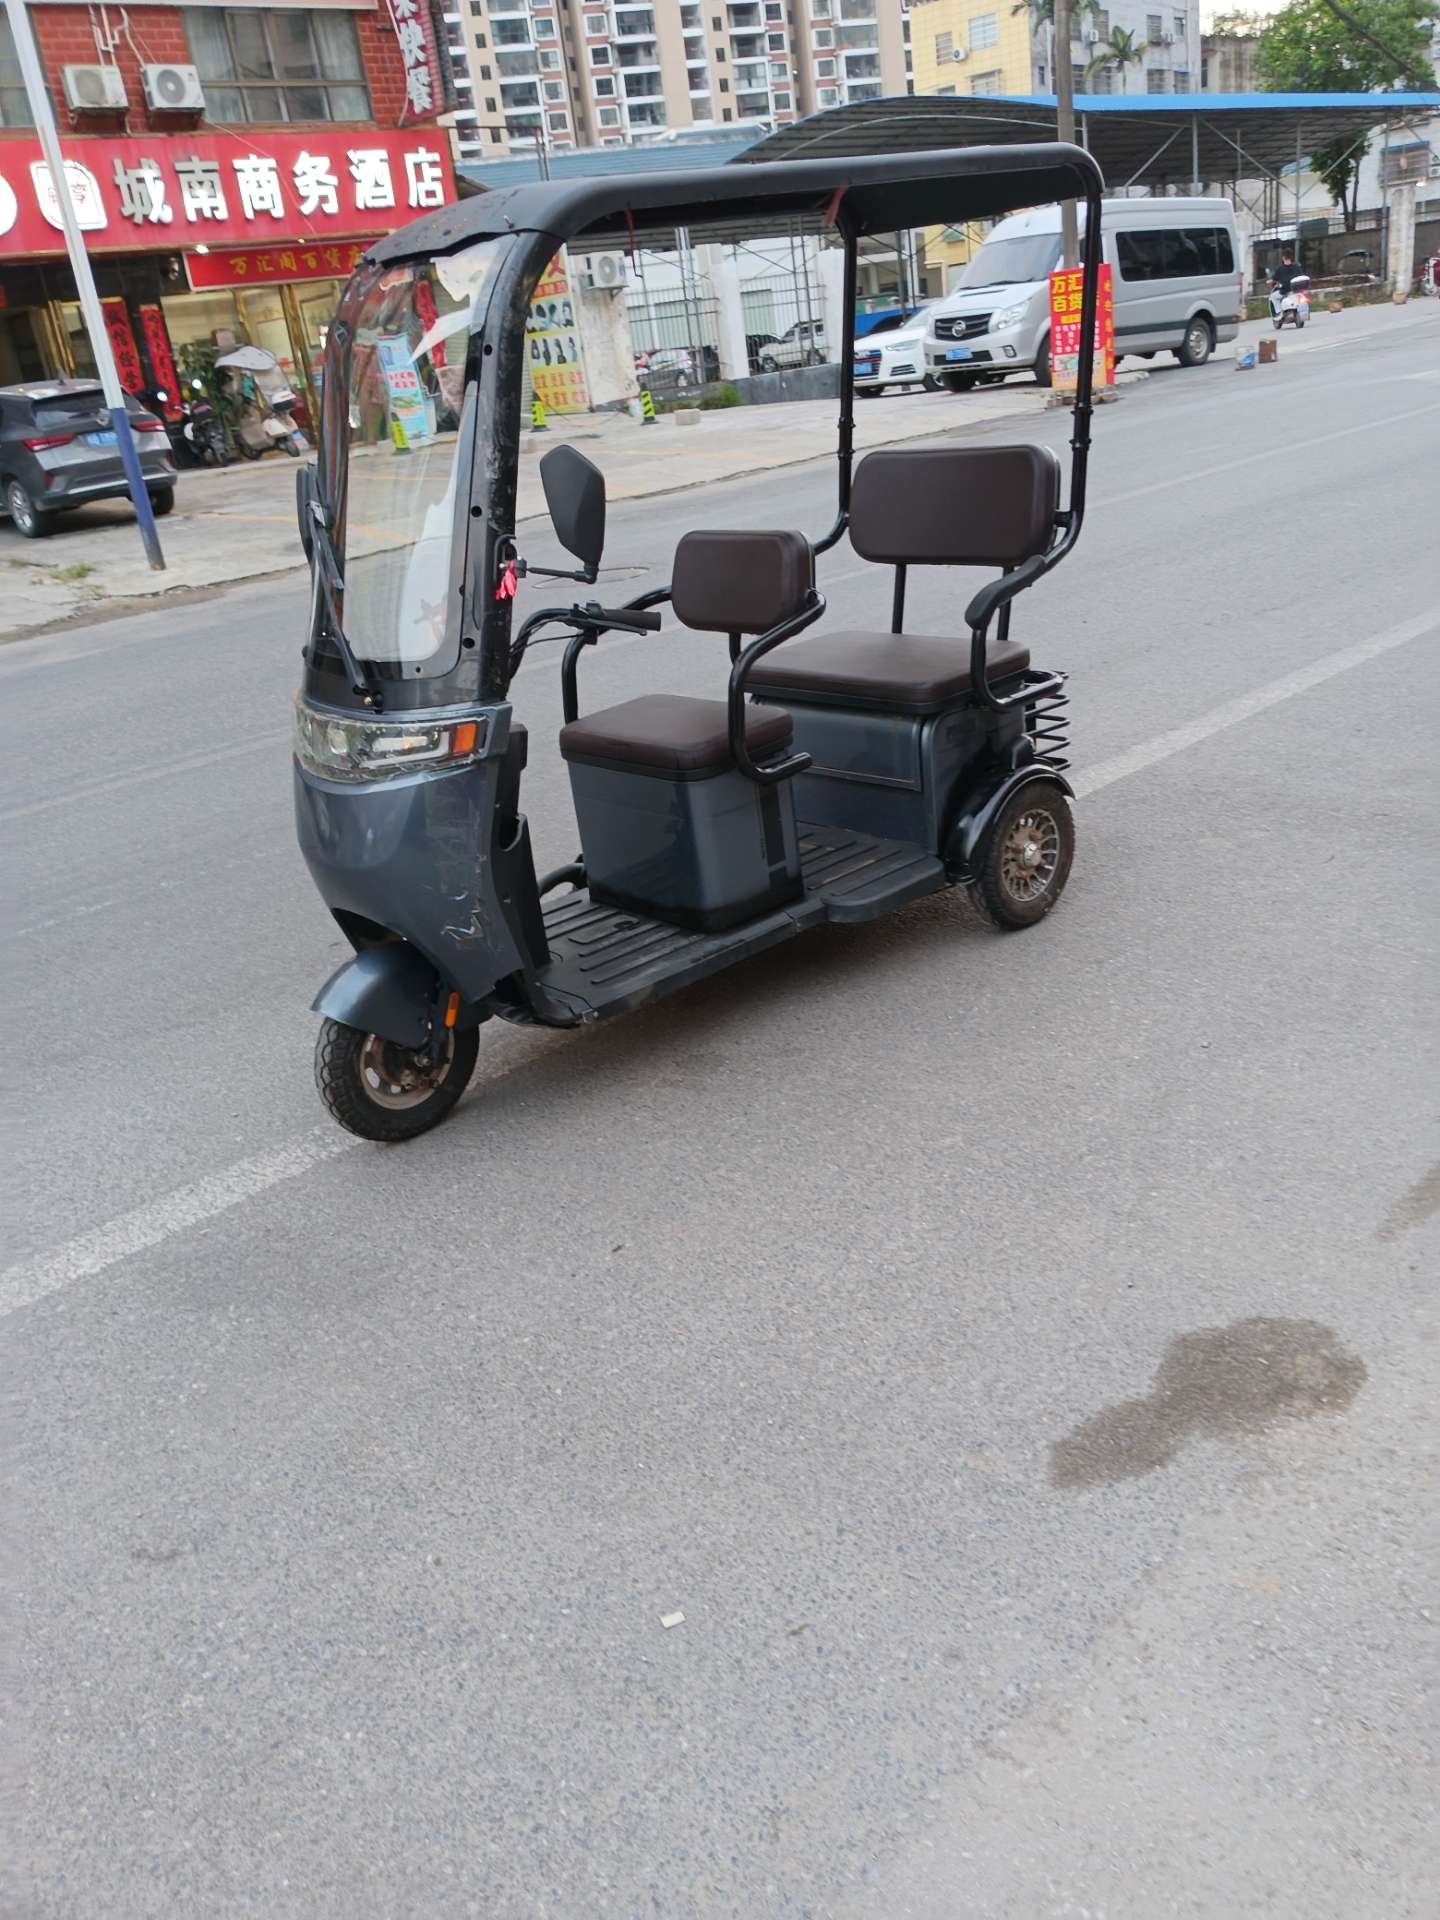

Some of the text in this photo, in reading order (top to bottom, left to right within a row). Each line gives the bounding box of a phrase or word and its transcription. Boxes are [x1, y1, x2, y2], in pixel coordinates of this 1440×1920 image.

[113, 147, 445, 224] 城南商务酒店
[1052, 291, 1100, 313] 百货
